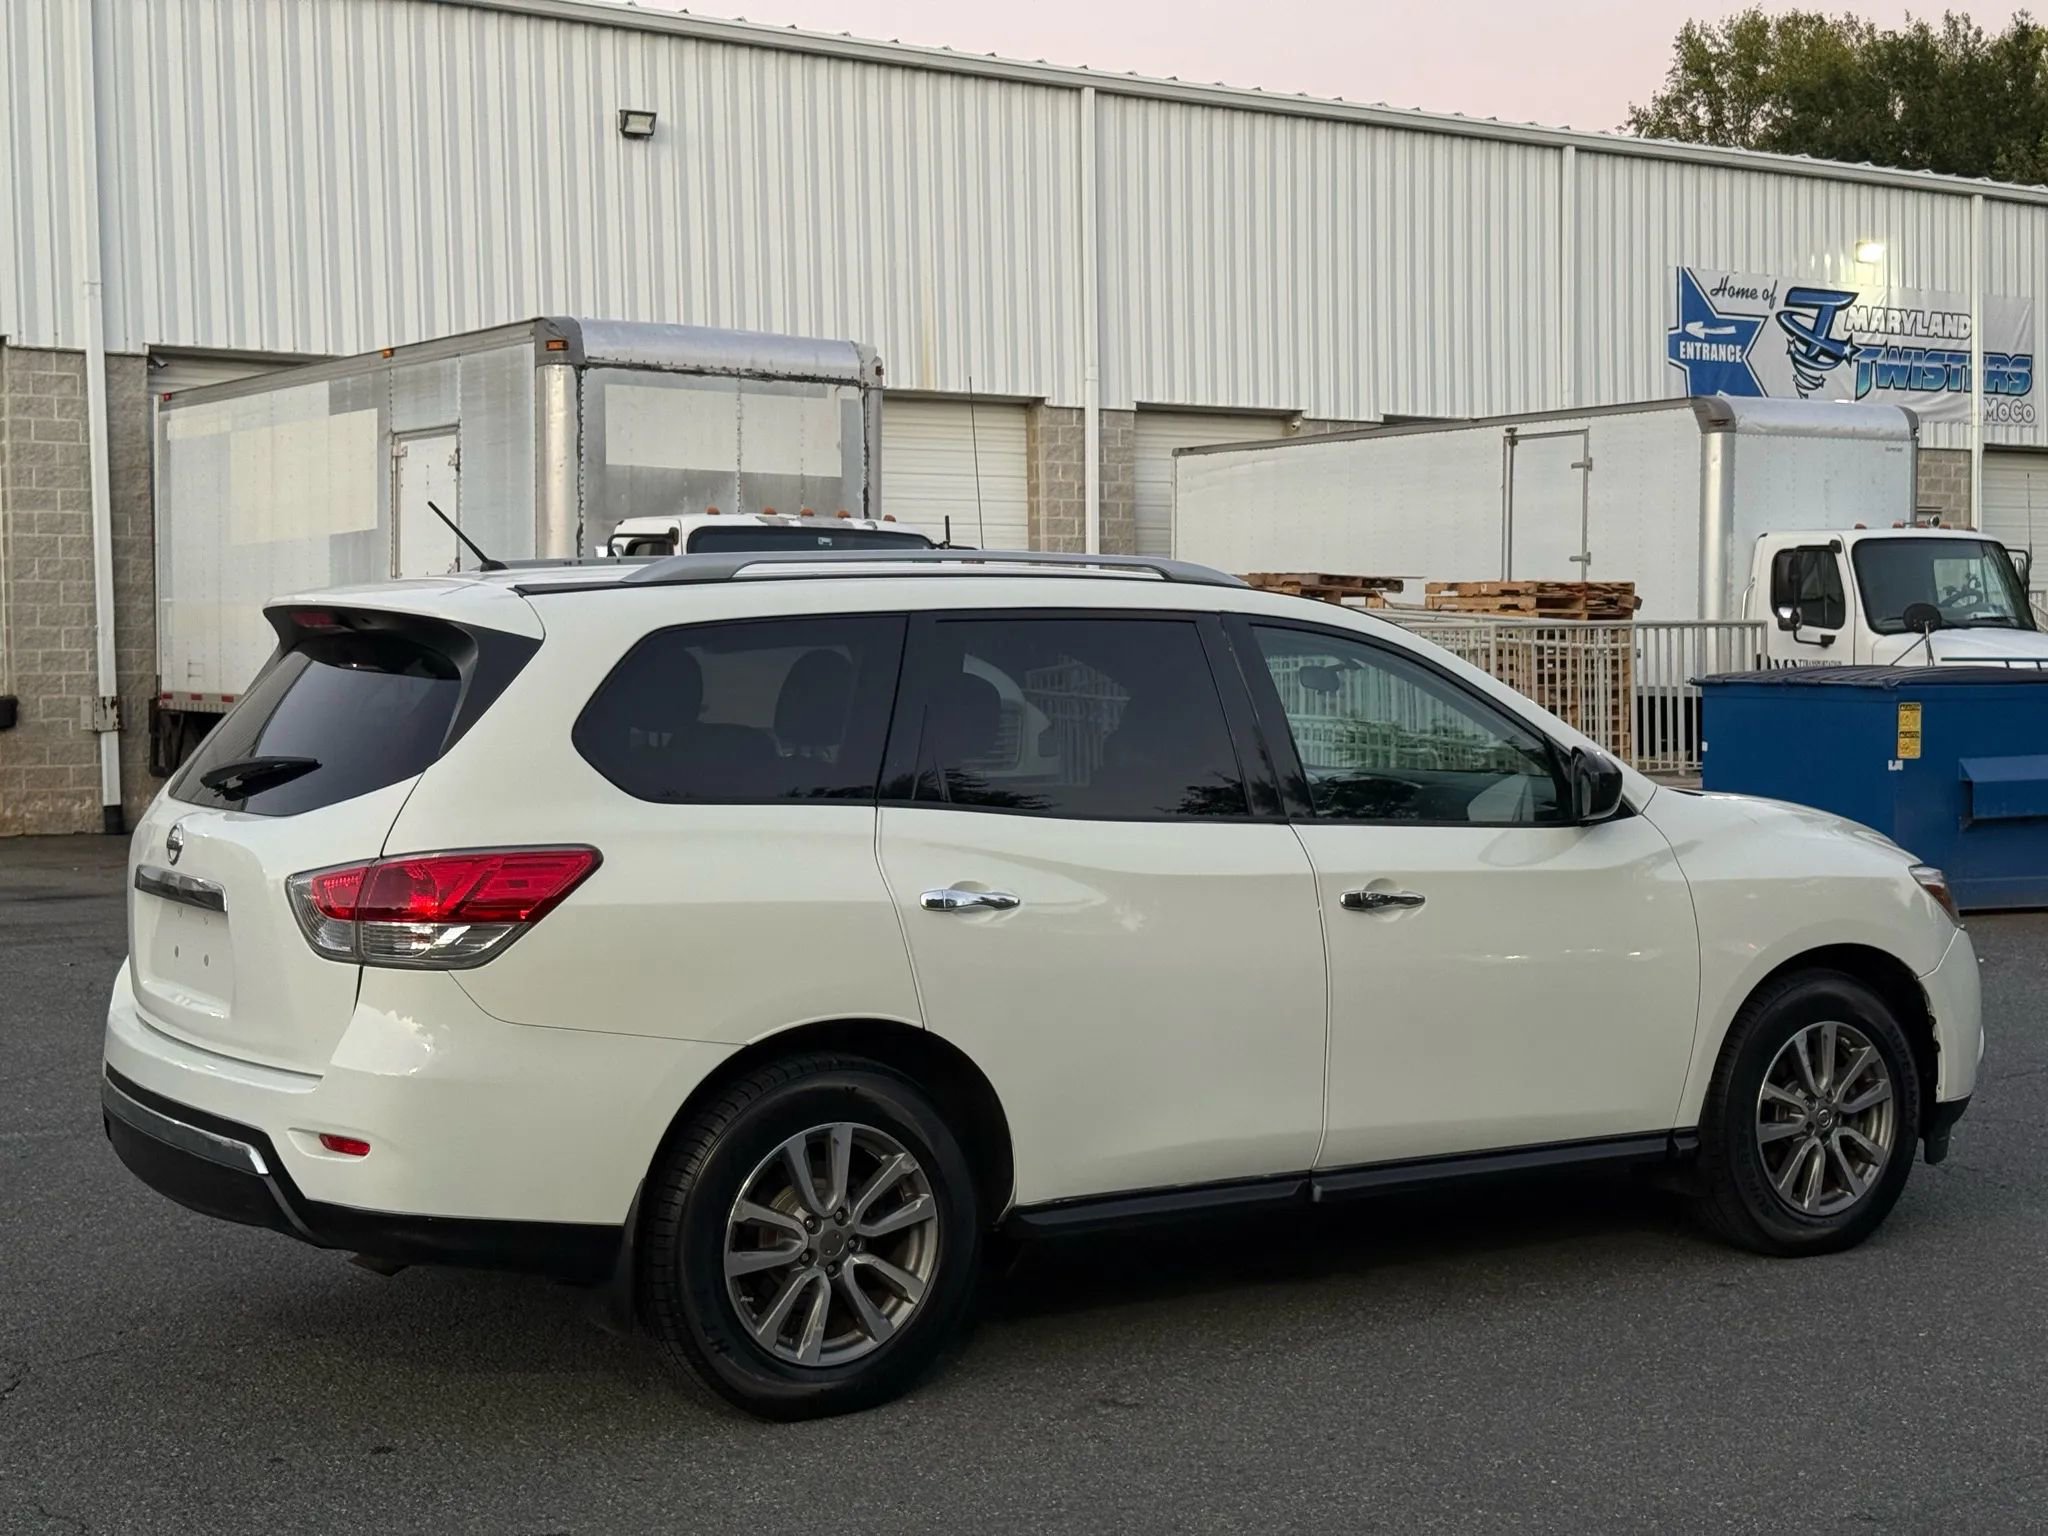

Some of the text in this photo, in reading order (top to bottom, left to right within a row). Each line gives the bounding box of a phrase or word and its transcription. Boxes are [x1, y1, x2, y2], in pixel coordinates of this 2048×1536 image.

[1710, 275, 1778, 310] Home of
[1844, 304, 1972, 340] MARYLAND
[1679, 340, 1743, 363] ENTRANCE
